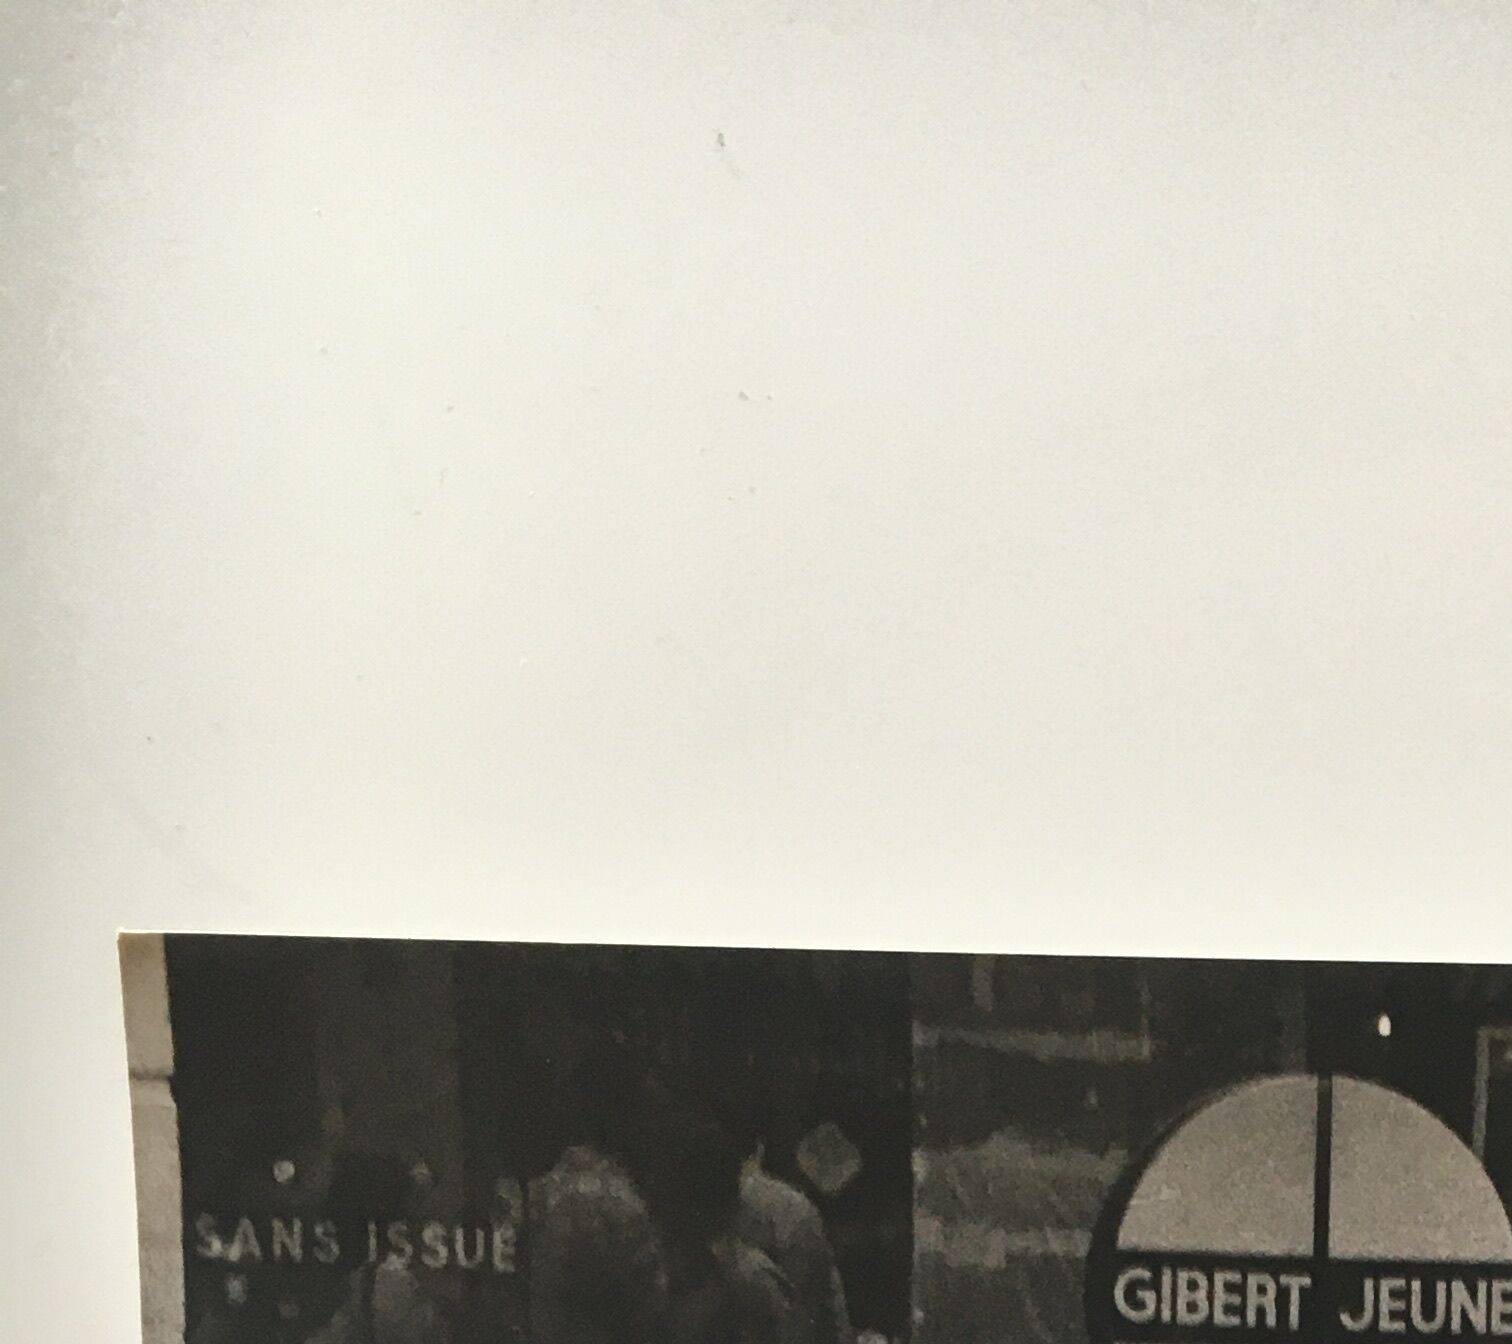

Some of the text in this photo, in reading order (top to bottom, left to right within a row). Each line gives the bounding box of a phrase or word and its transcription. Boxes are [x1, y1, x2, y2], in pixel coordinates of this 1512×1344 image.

[196, 1212, 516, 1274] SANS ISSUE
[1113, 1266, 1312, 1333] GIBERT
